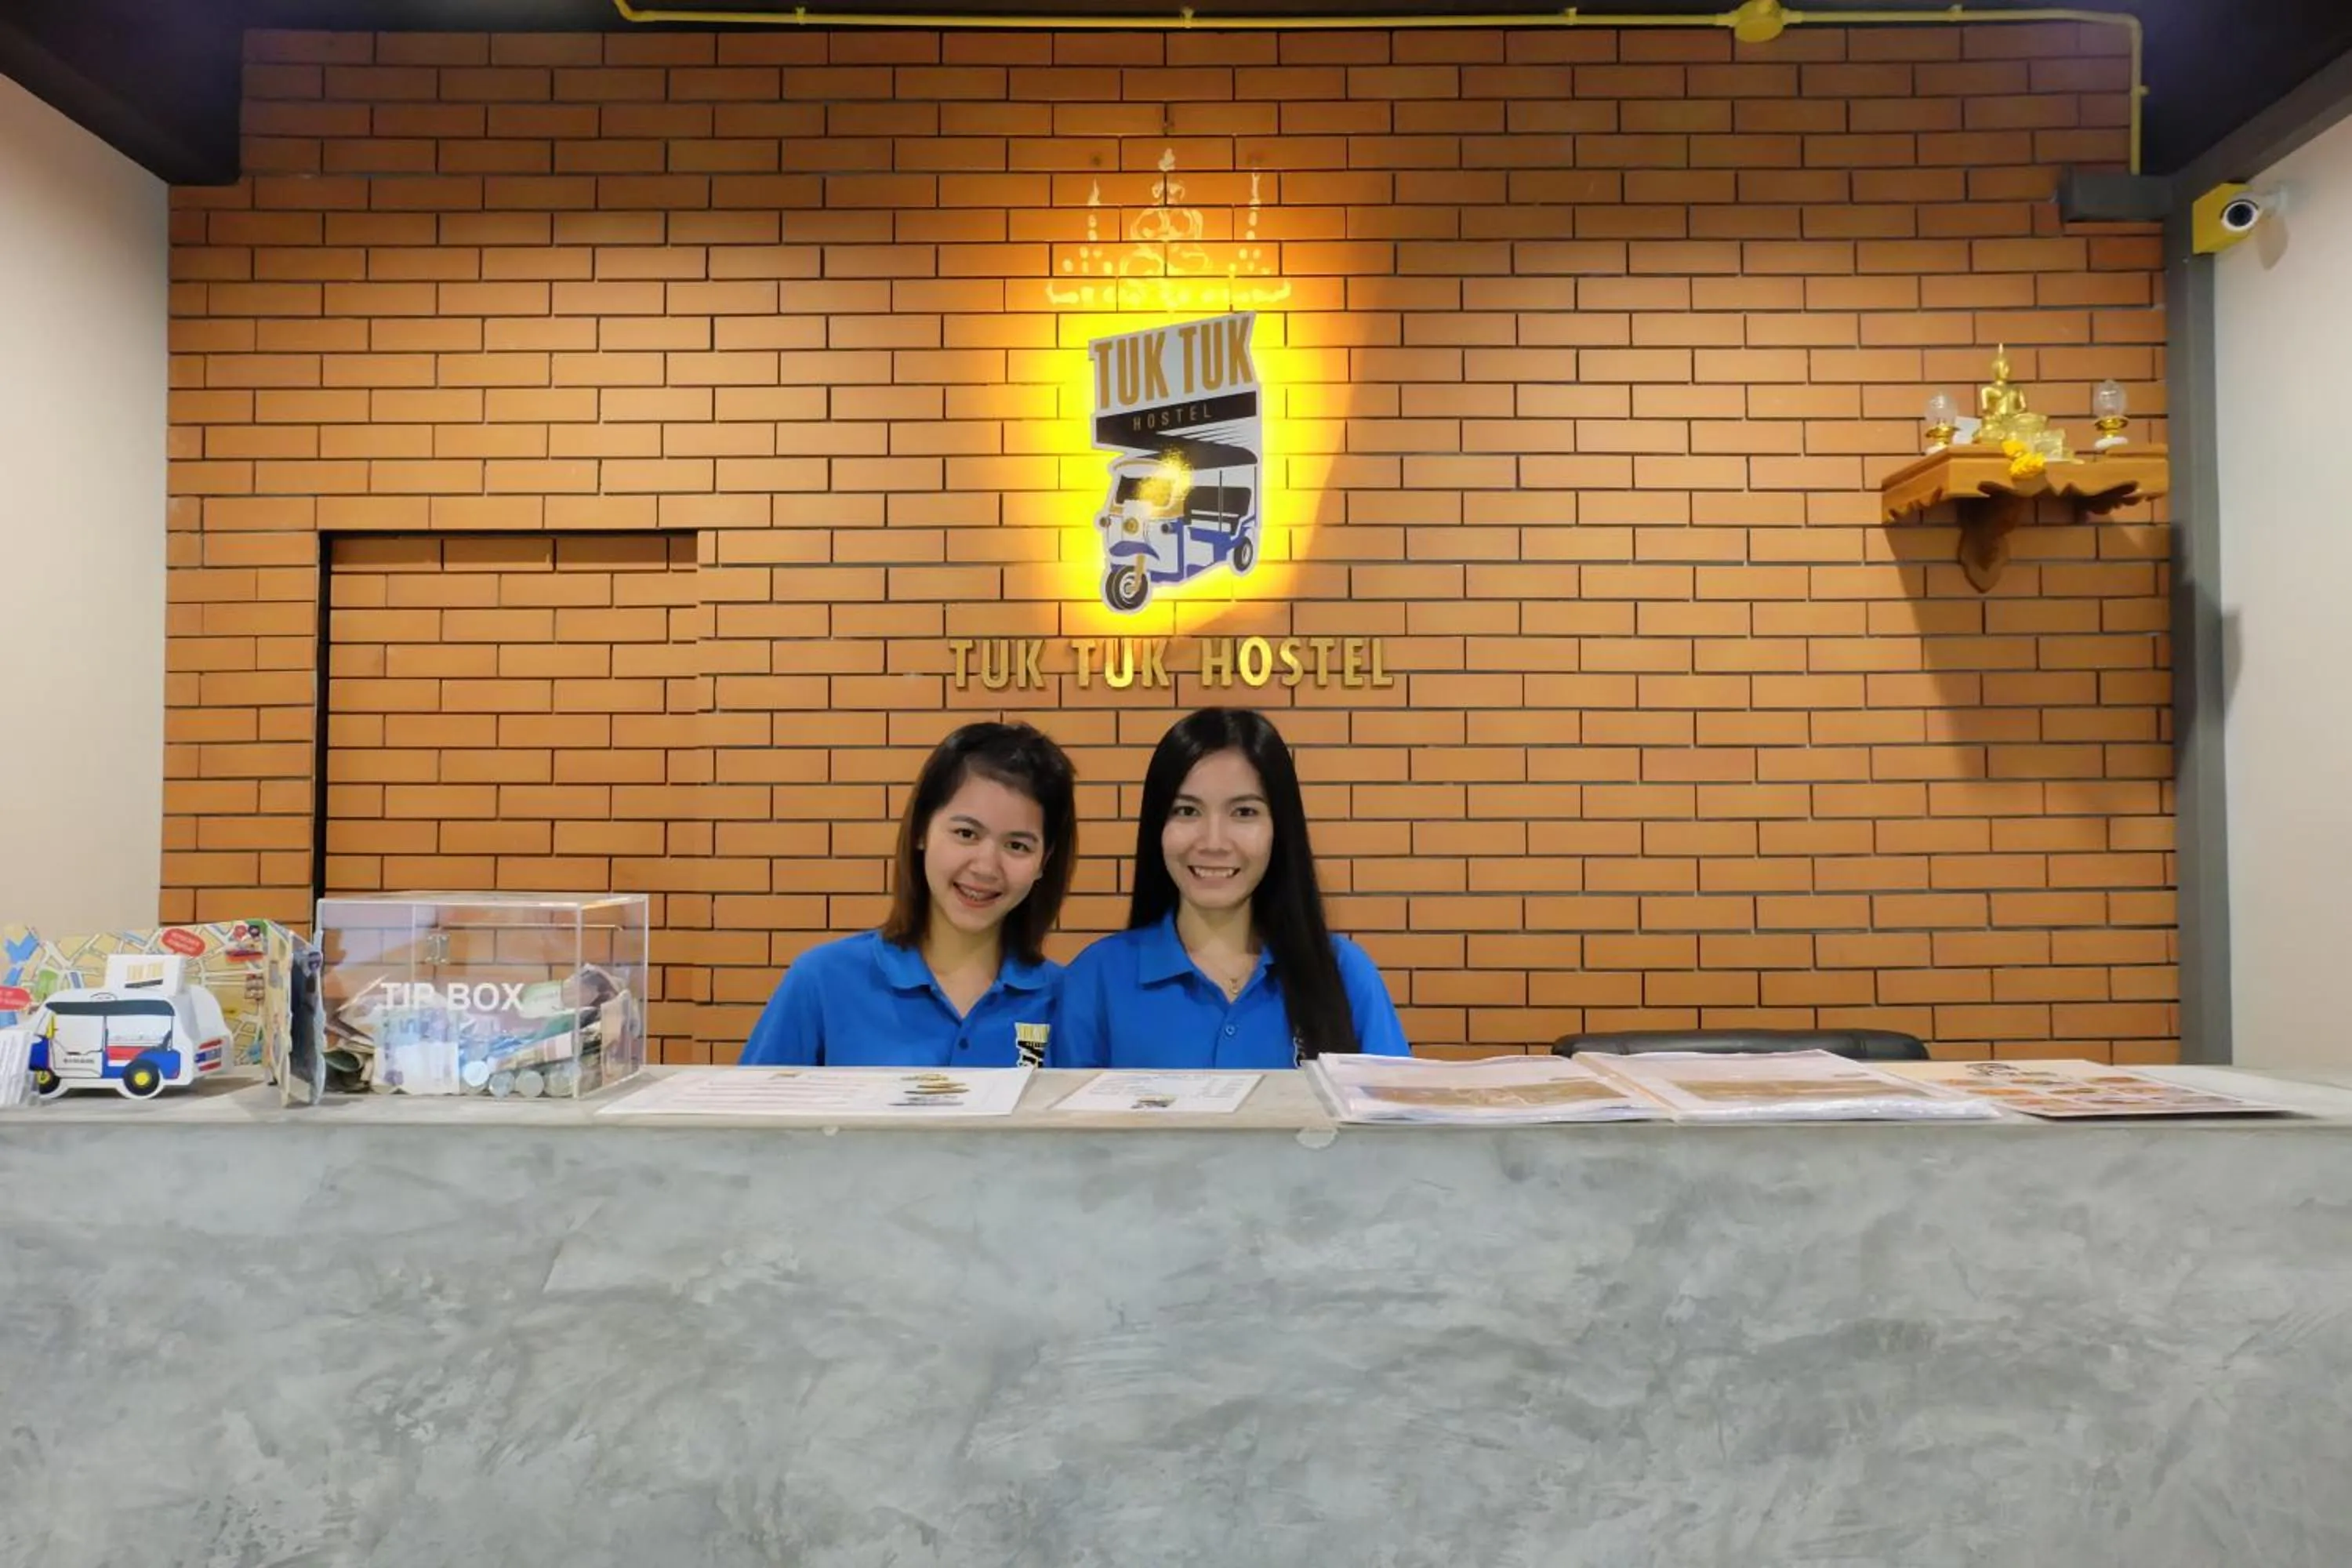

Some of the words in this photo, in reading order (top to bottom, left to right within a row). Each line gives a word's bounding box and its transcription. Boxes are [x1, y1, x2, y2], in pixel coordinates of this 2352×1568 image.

[1094, 331, 1169, 410] TUK
[1178, 316, 1253, 394] TUK
[1133, 403, 1213, 431] HOSTEL
[949, 639, 1045, 688] TUK
[1071, 639, 1172, 688] TUK
[1201, 637, 1395, 688] HOSTEL
[380, 982, 437, 1011] TIP
[447, 982, 524, 1011] BOX
